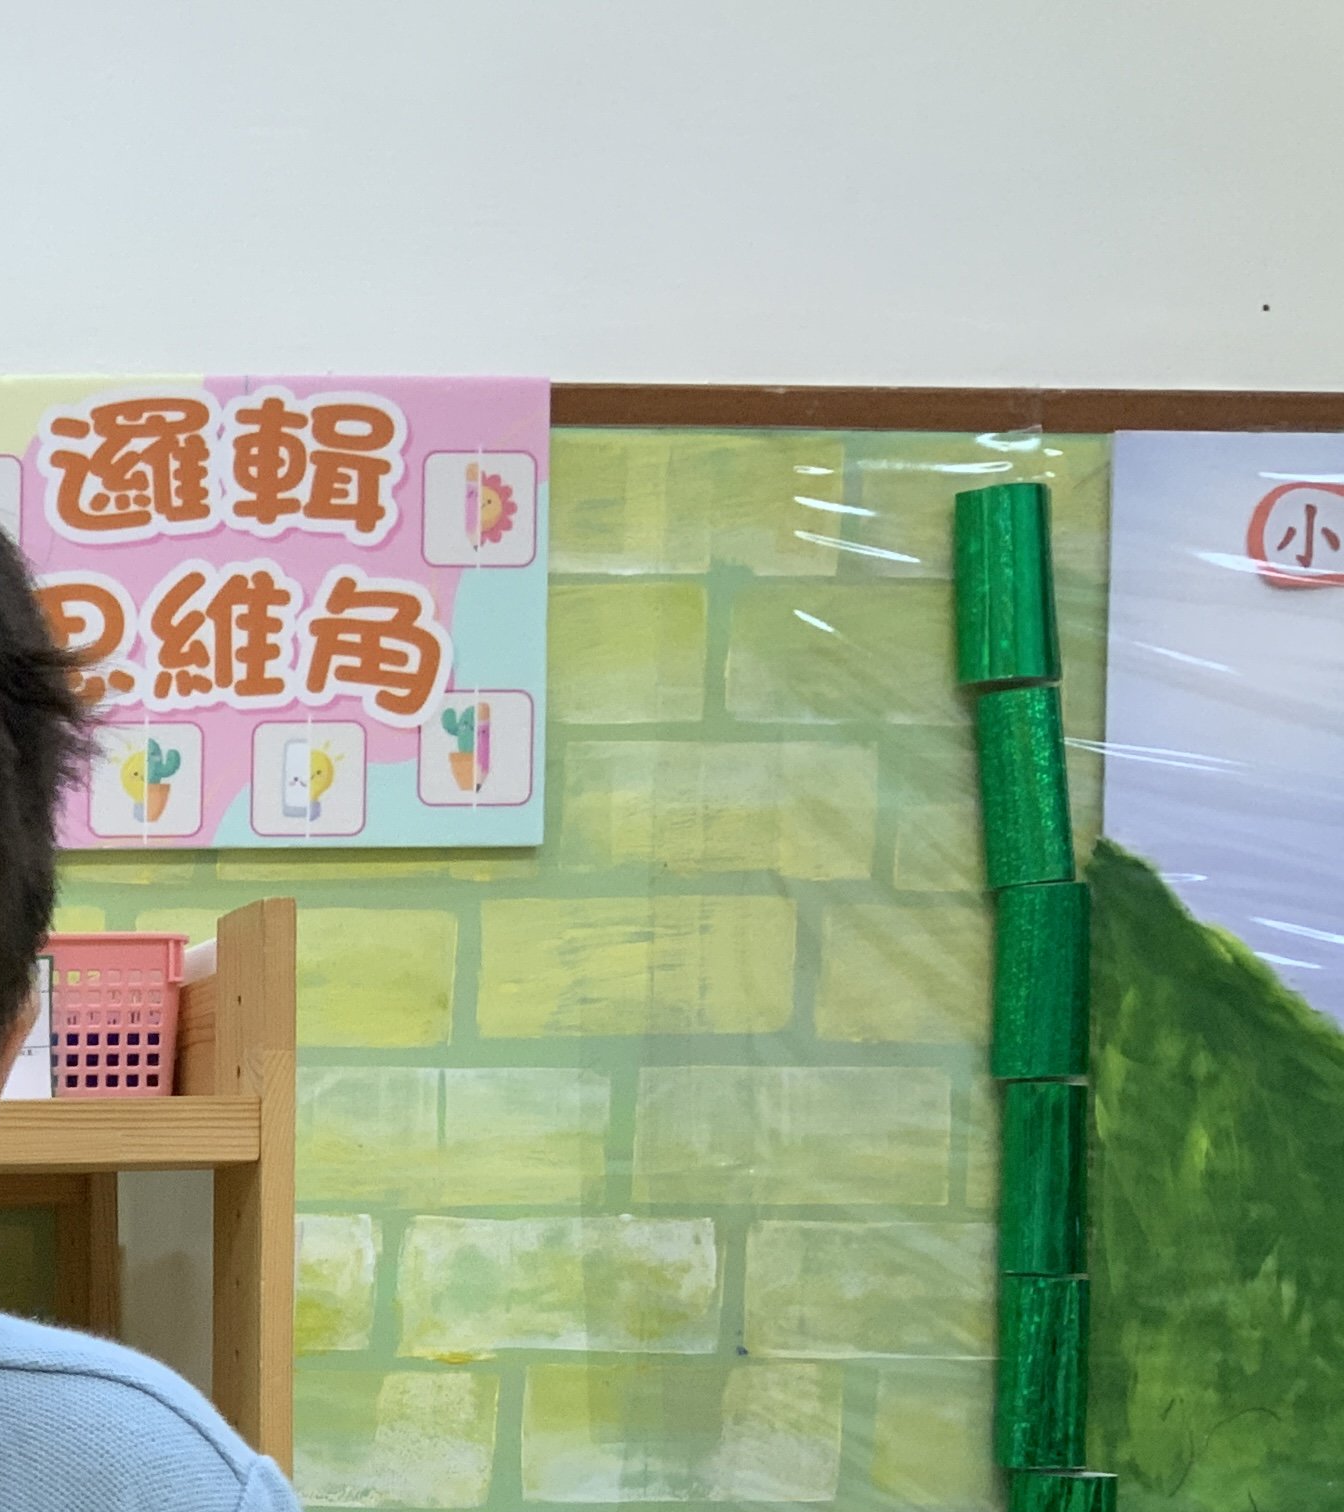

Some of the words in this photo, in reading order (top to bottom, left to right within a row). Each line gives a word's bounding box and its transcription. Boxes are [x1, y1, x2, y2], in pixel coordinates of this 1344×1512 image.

[50, 396, 396, 534] 邏輯
[1276, 503, 1341, 569] 小
[34, 569, 443, 716] 思維角
